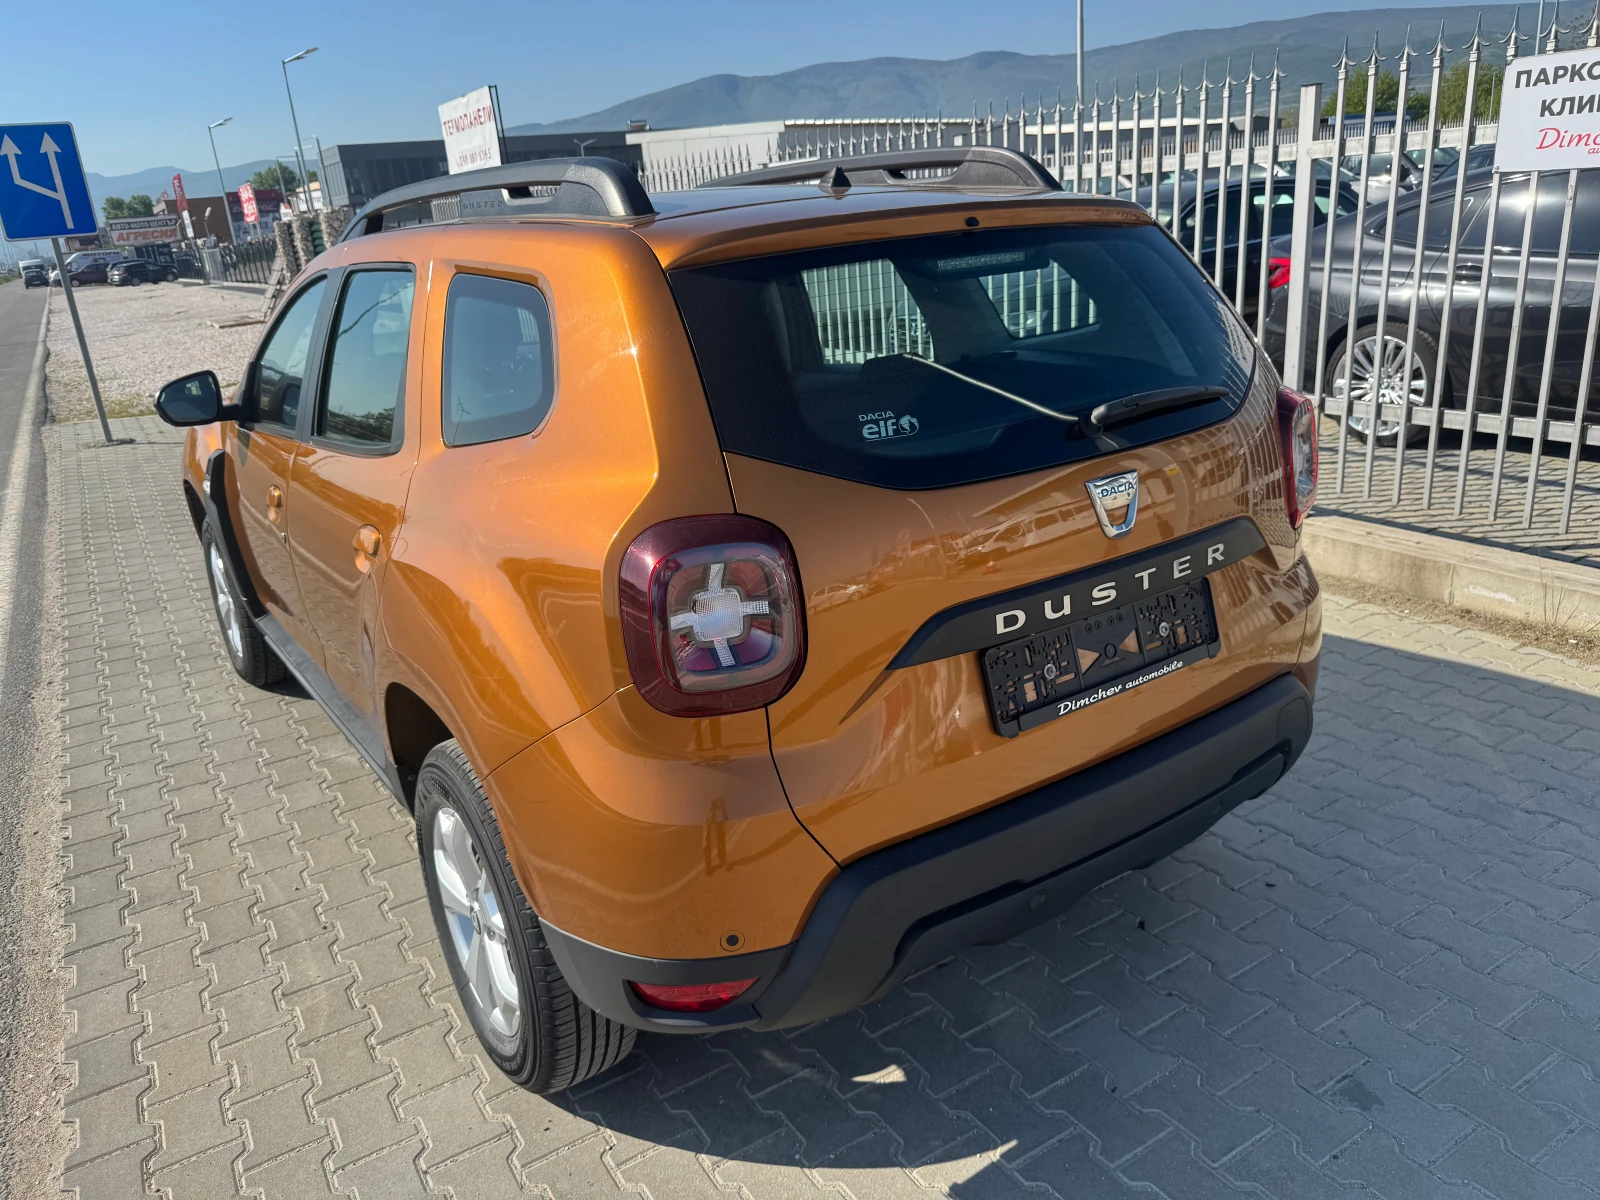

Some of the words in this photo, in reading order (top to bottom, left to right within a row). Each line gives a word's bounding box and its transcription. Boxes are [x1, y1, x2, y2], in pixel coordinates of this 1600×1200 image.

[463, 200, 503, 210] DUSTER
[116, 228, 177, 242] АГРЕСИЯ
[858, 410, 895, 422] DACIA
[862, 418, 897, 439] elf
[1101, 481, 1135, 498] DACIA
[995, 542, 1225, 635] DUSTER
[1057, 684, 1122, 716] Dimchev
[1125, 660, 1184, 689] automobile
